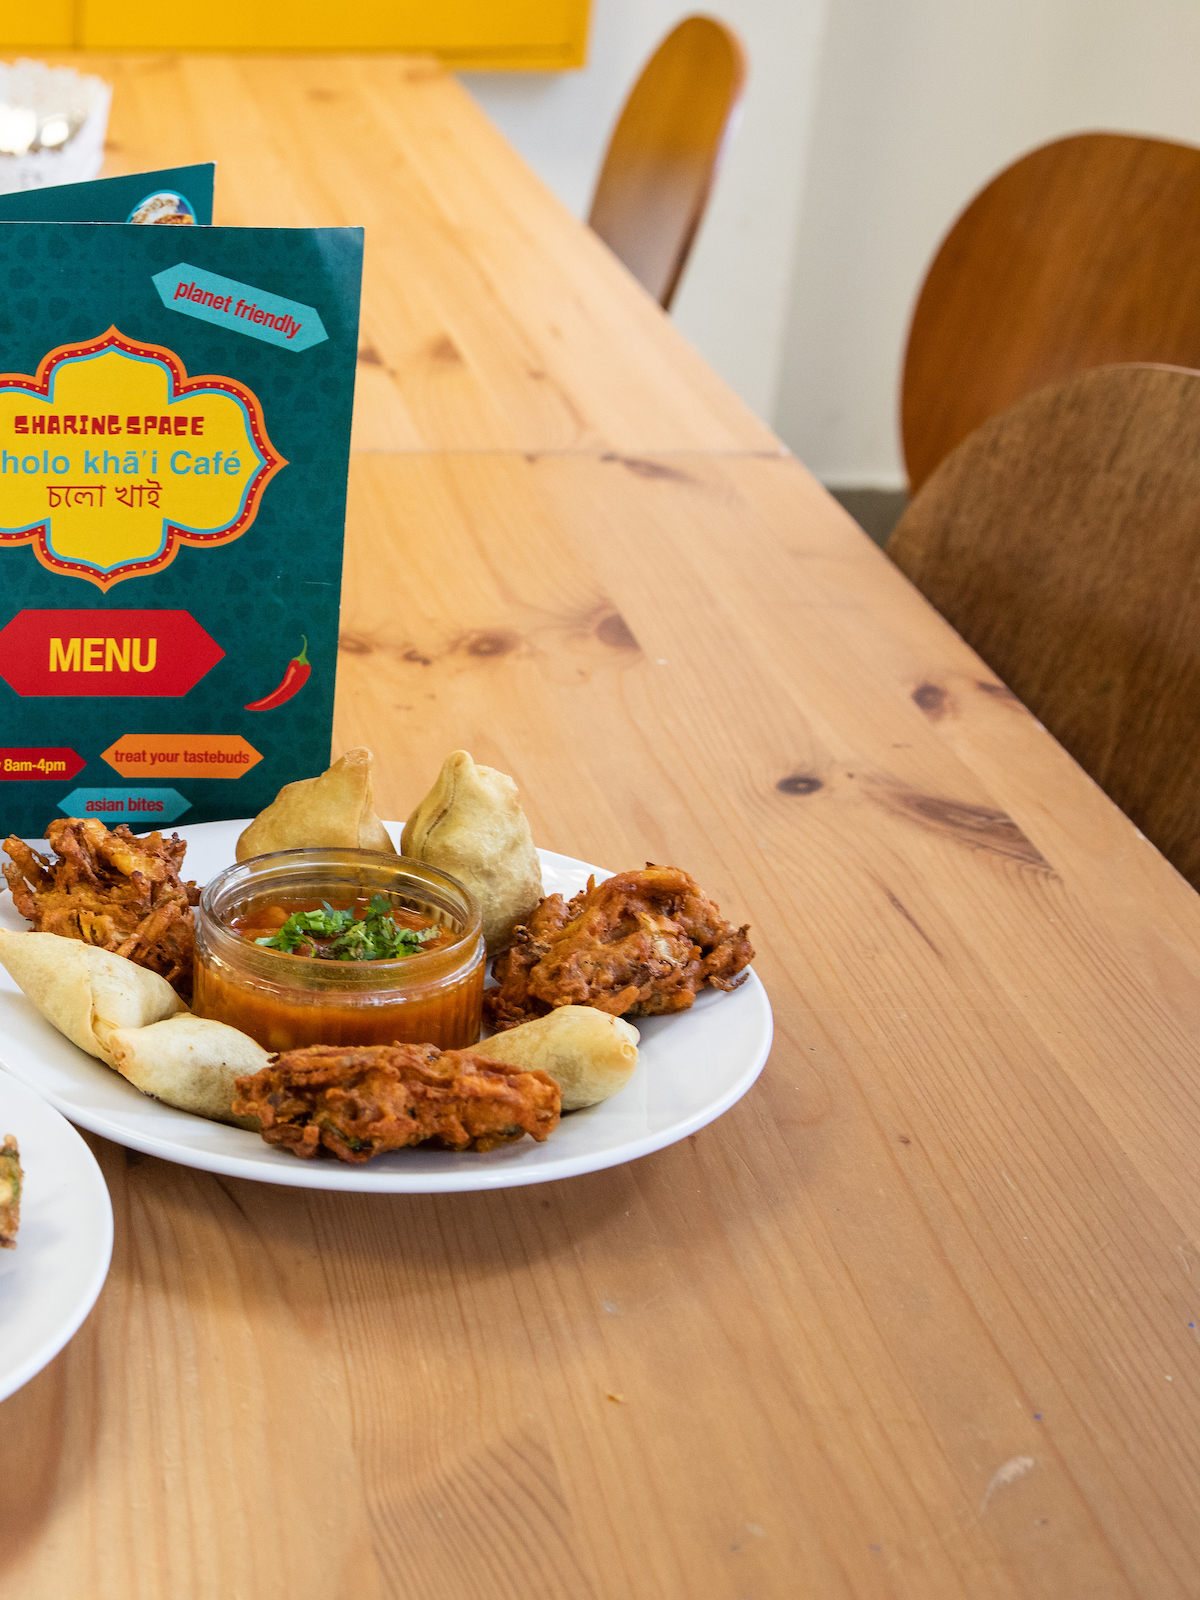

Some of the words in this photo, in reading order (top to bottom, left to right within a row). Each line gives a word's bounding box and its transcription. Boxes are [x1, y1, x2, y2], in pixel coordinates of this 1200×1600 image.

[173, 281, 233, 313] planet
[234, 299, 302, 340] friendly
[14, 415, 122, 436] SHARING
[126, 416, 205, 436] SPACE
[169, 449, 242, 476] Café
[46, 484, 107, 508] চলো
[115, 478, 163, 509] খাই
[49, 637, 158, 673] MENU
[3, 757, 67, 775] 8am-4pm
[114, 749, 147, 763] treat
[150, 752, 181, 766] your
[183, 750, 251, 765] tastebuds
[85, 797, 125, 813] asian
[127, 797, 165, 813] bites
